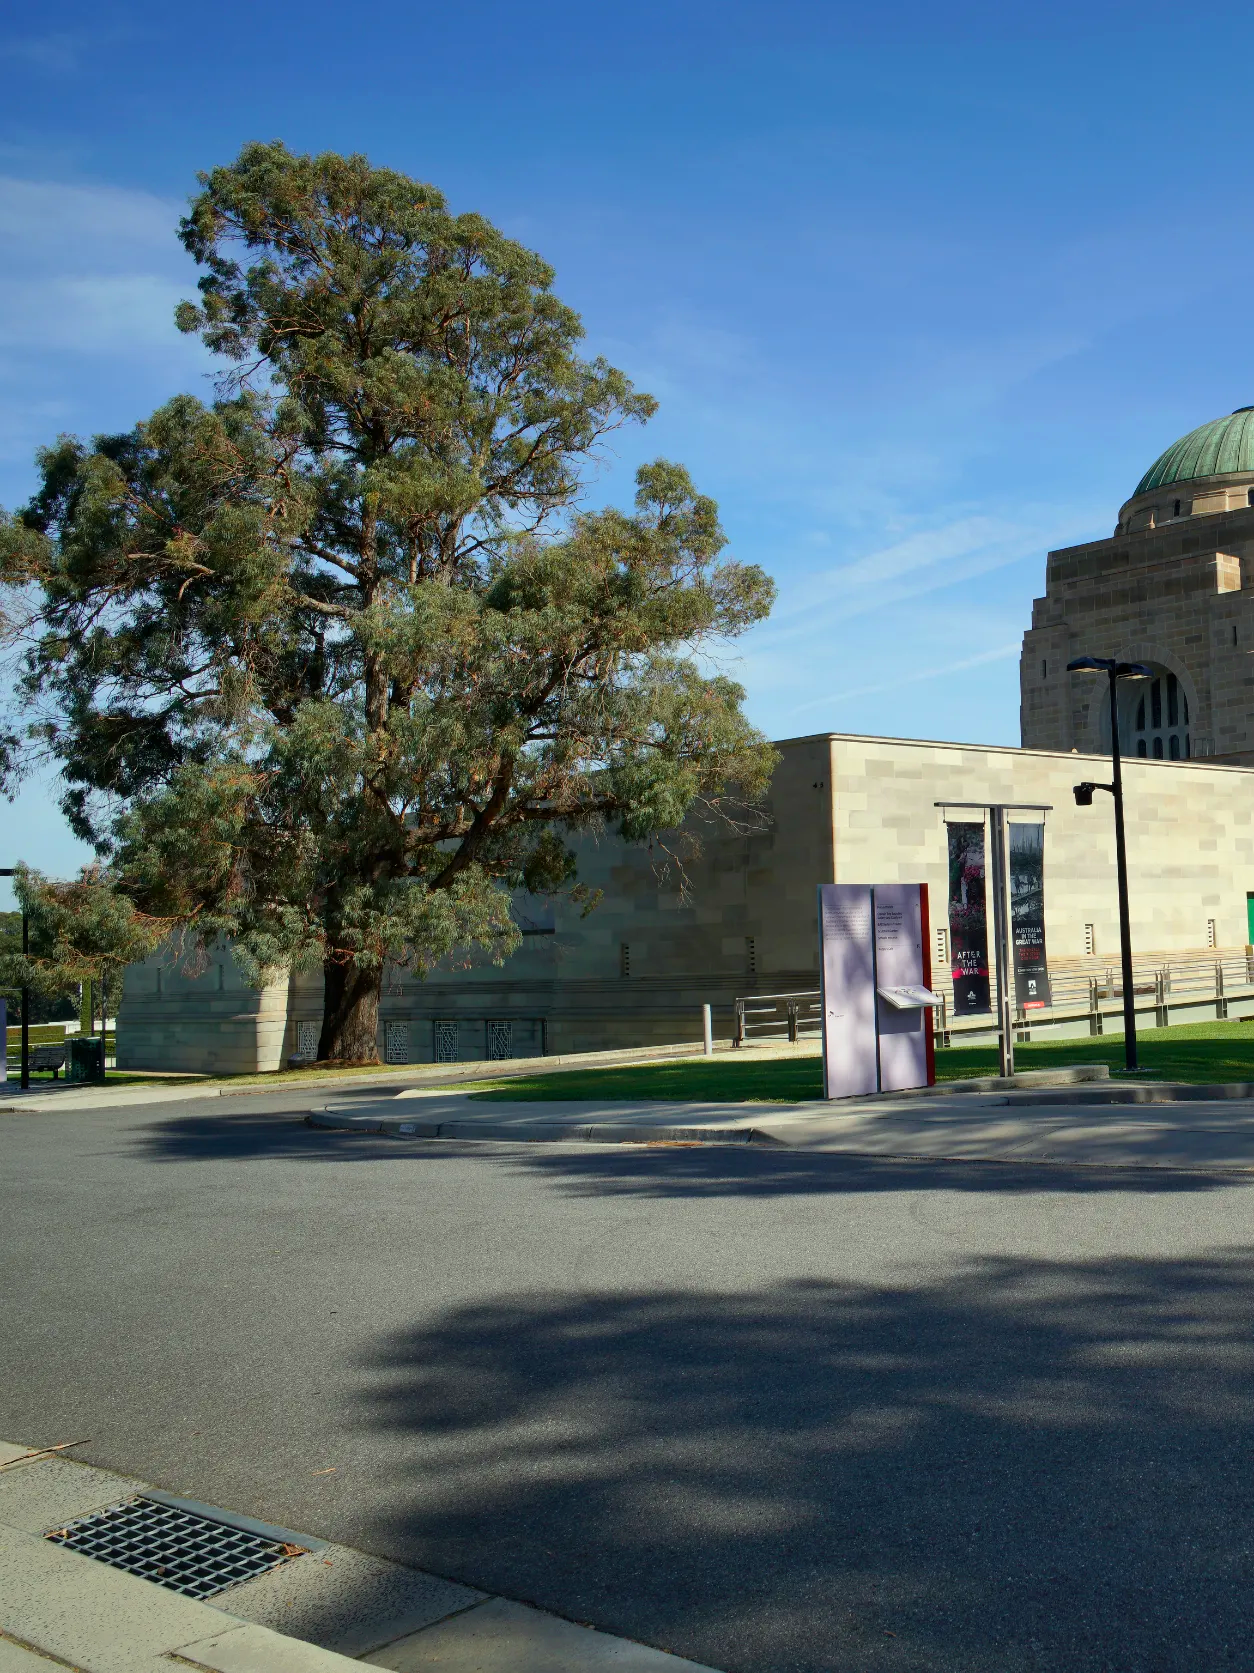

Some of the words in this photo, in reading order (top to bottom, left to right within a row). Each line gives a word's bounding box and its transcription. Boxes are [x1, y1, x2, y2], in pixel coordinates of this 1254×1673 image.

[957, 951, 981, 959] AFTER
[961, 960, 978, 968] THE
[960, 968, 980, 976] WAR
